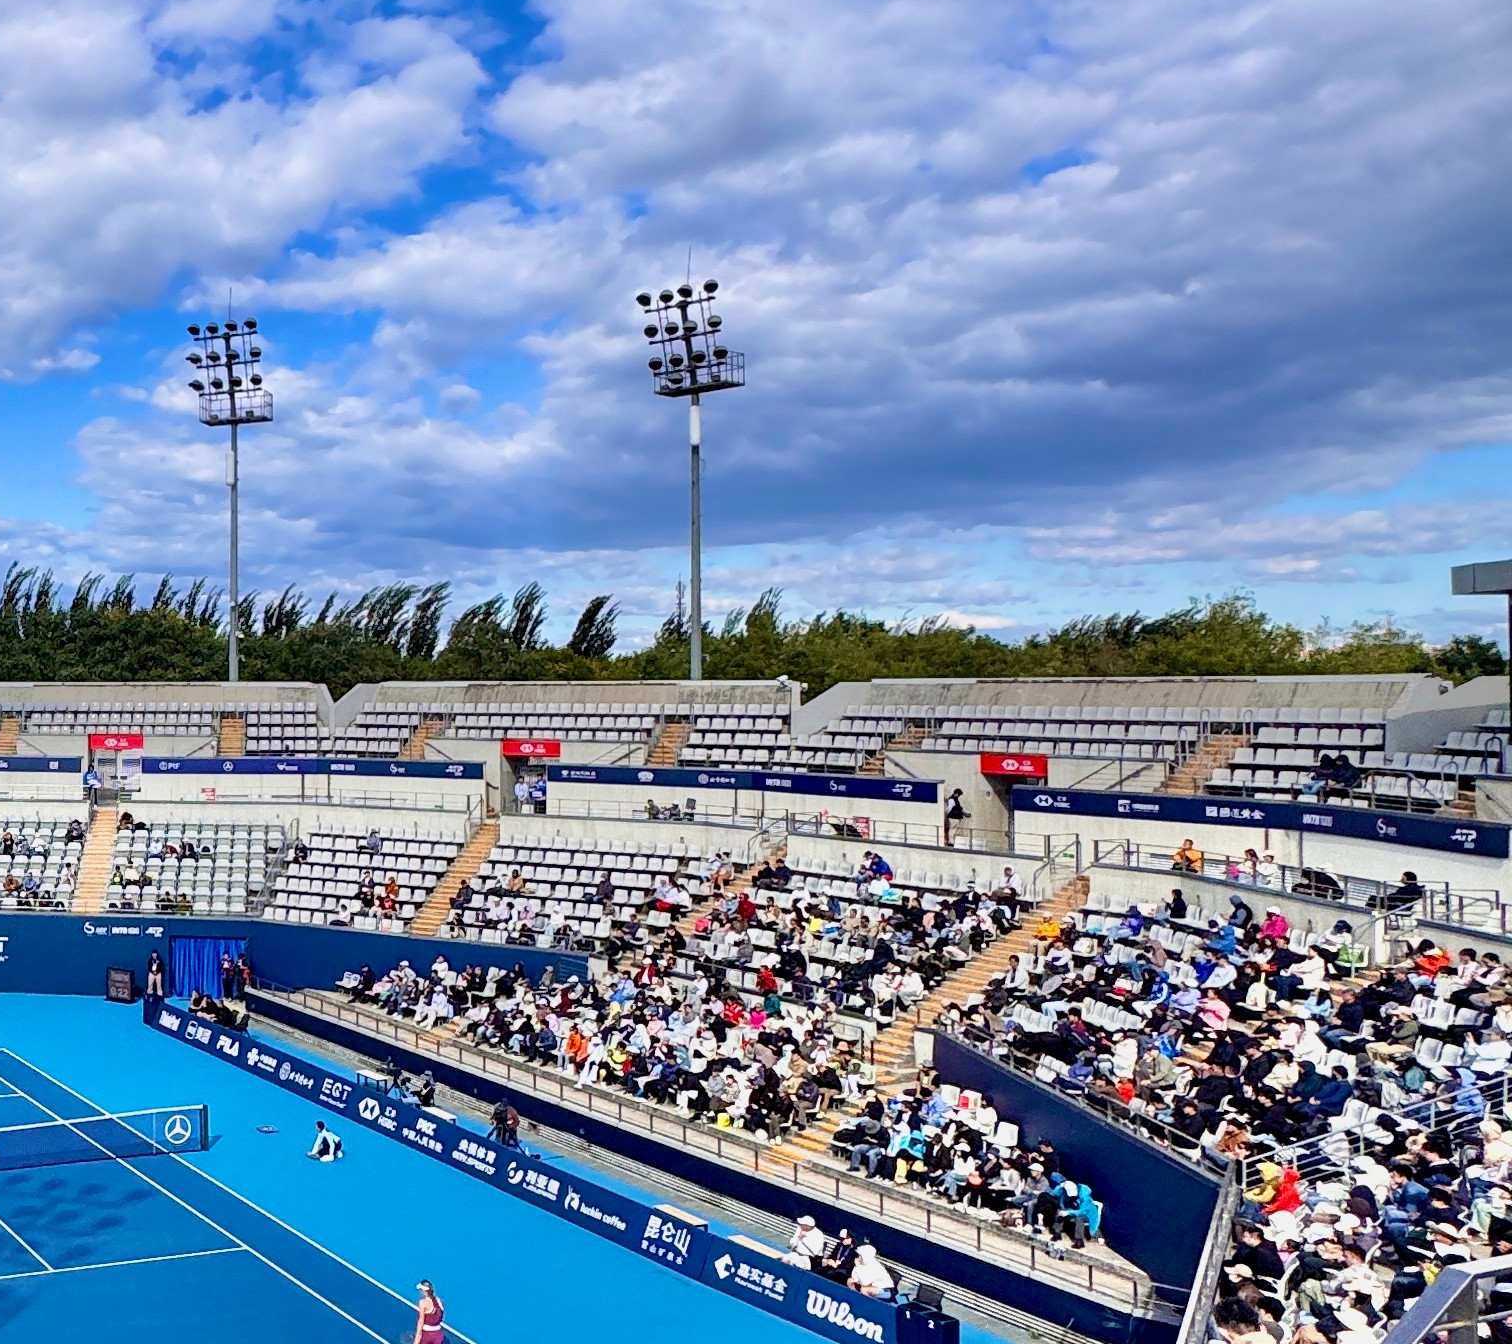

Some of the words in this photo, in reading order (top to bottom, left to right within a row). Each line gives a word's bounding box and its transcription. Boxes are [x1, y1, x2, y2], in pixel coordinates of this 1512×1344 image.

[216, 1034, 240, 1057] FILA
[321, 1077, 353, 1101] EQT
[377, 1115, 398, 1132] HSBC
[602, 1212, 627, 1231] coffee
[643, 1214, 691, 1259] 昆仑山
[806, 1288, 885, 1344] Wilson
[905, 1310, 911, 1319] 1
[928, 1319, 935, 1329] 2
